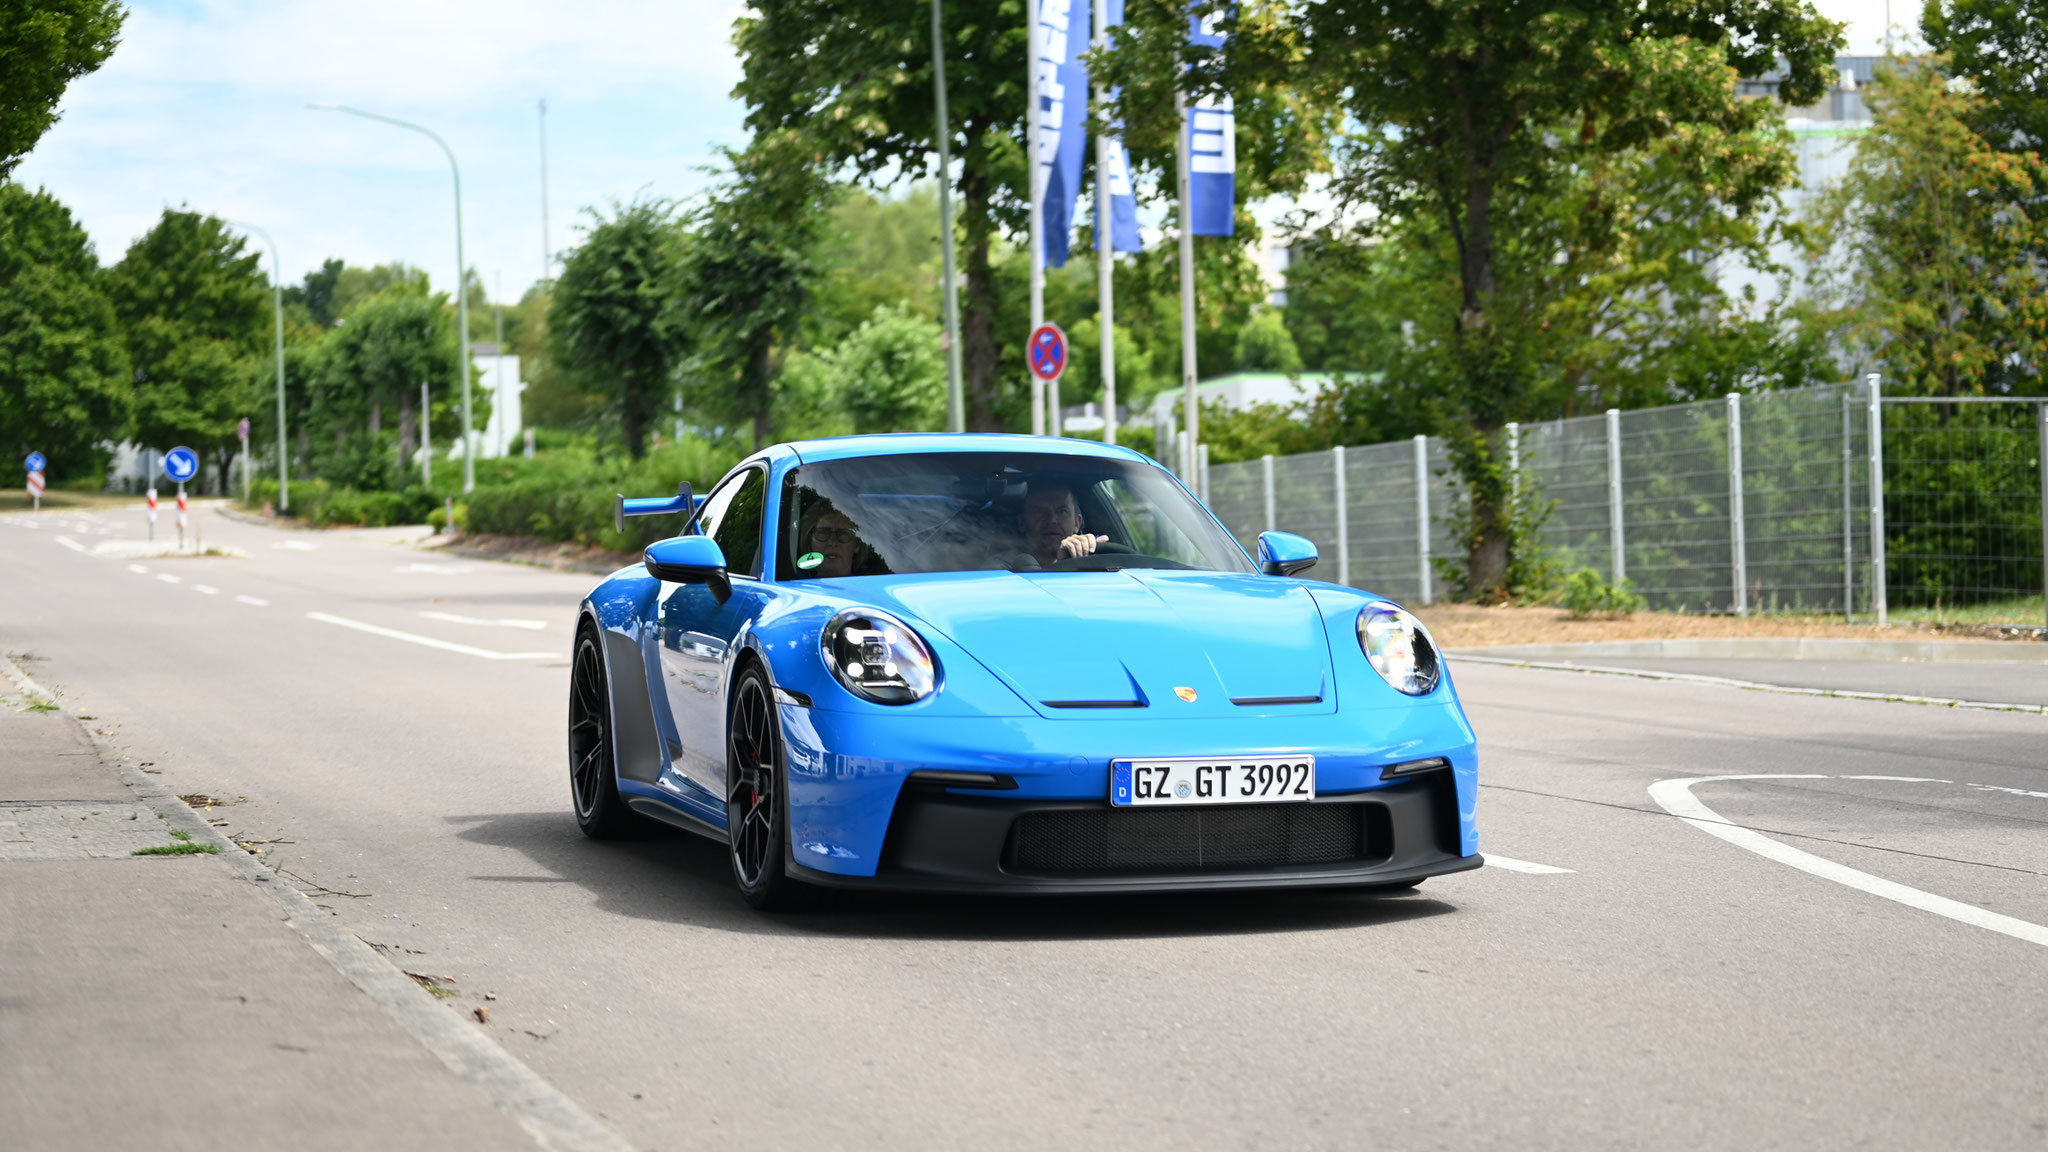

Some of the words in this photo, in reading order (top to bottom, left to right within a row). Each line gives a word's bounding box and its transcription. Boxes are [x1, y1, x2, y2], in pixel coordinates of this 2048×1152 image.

[1135, 767, 1171, 798] GZ
[1196, 765, 1232, 797] GT
[1240, 763, 1310, 796] 3992
[1119, 787, 1127, 797] D
